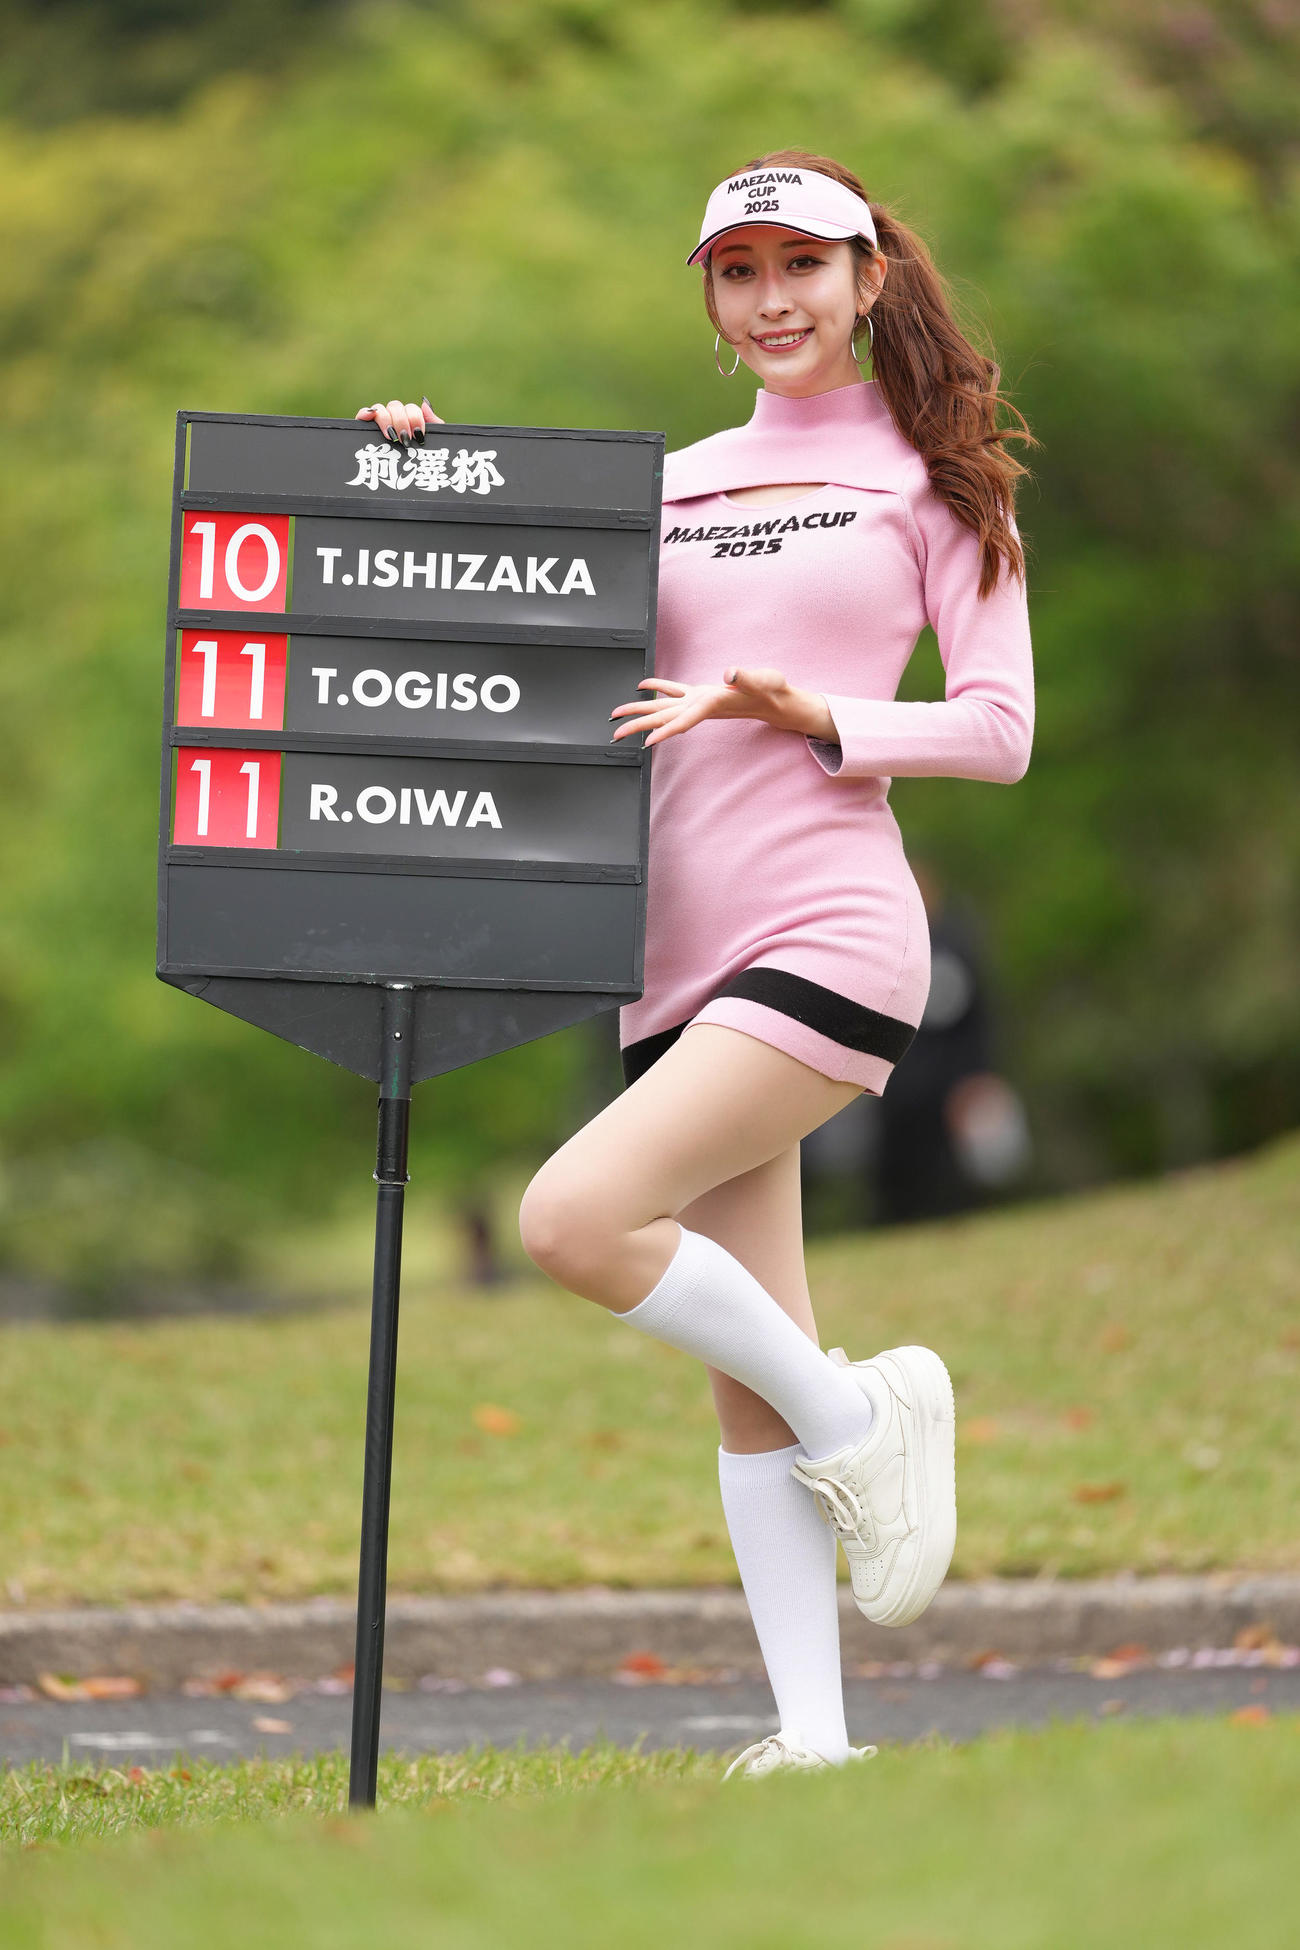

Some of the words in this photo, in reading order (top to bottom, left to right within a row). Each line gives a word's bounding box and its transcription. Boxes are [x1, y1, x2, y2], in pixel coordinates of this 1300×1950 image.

[727, 173, 802, 194] MAEZAWA
[748, 186, 776, 198] CUP
[745, 200, 779, 215] 2025
[345, 443, 505, 495] 前澤杯
[190, 522, 280, 602] 10
[316, 547, 597, 596] T.ISHIZAKA
[711, 538, 783, 558] 2025
[192, 641, 266, 719] 11
[311, 667, 521, 713] T.OGISO
[190, 759, 260, 838] 11
[309, 784, 503, 829] R.OIWA
